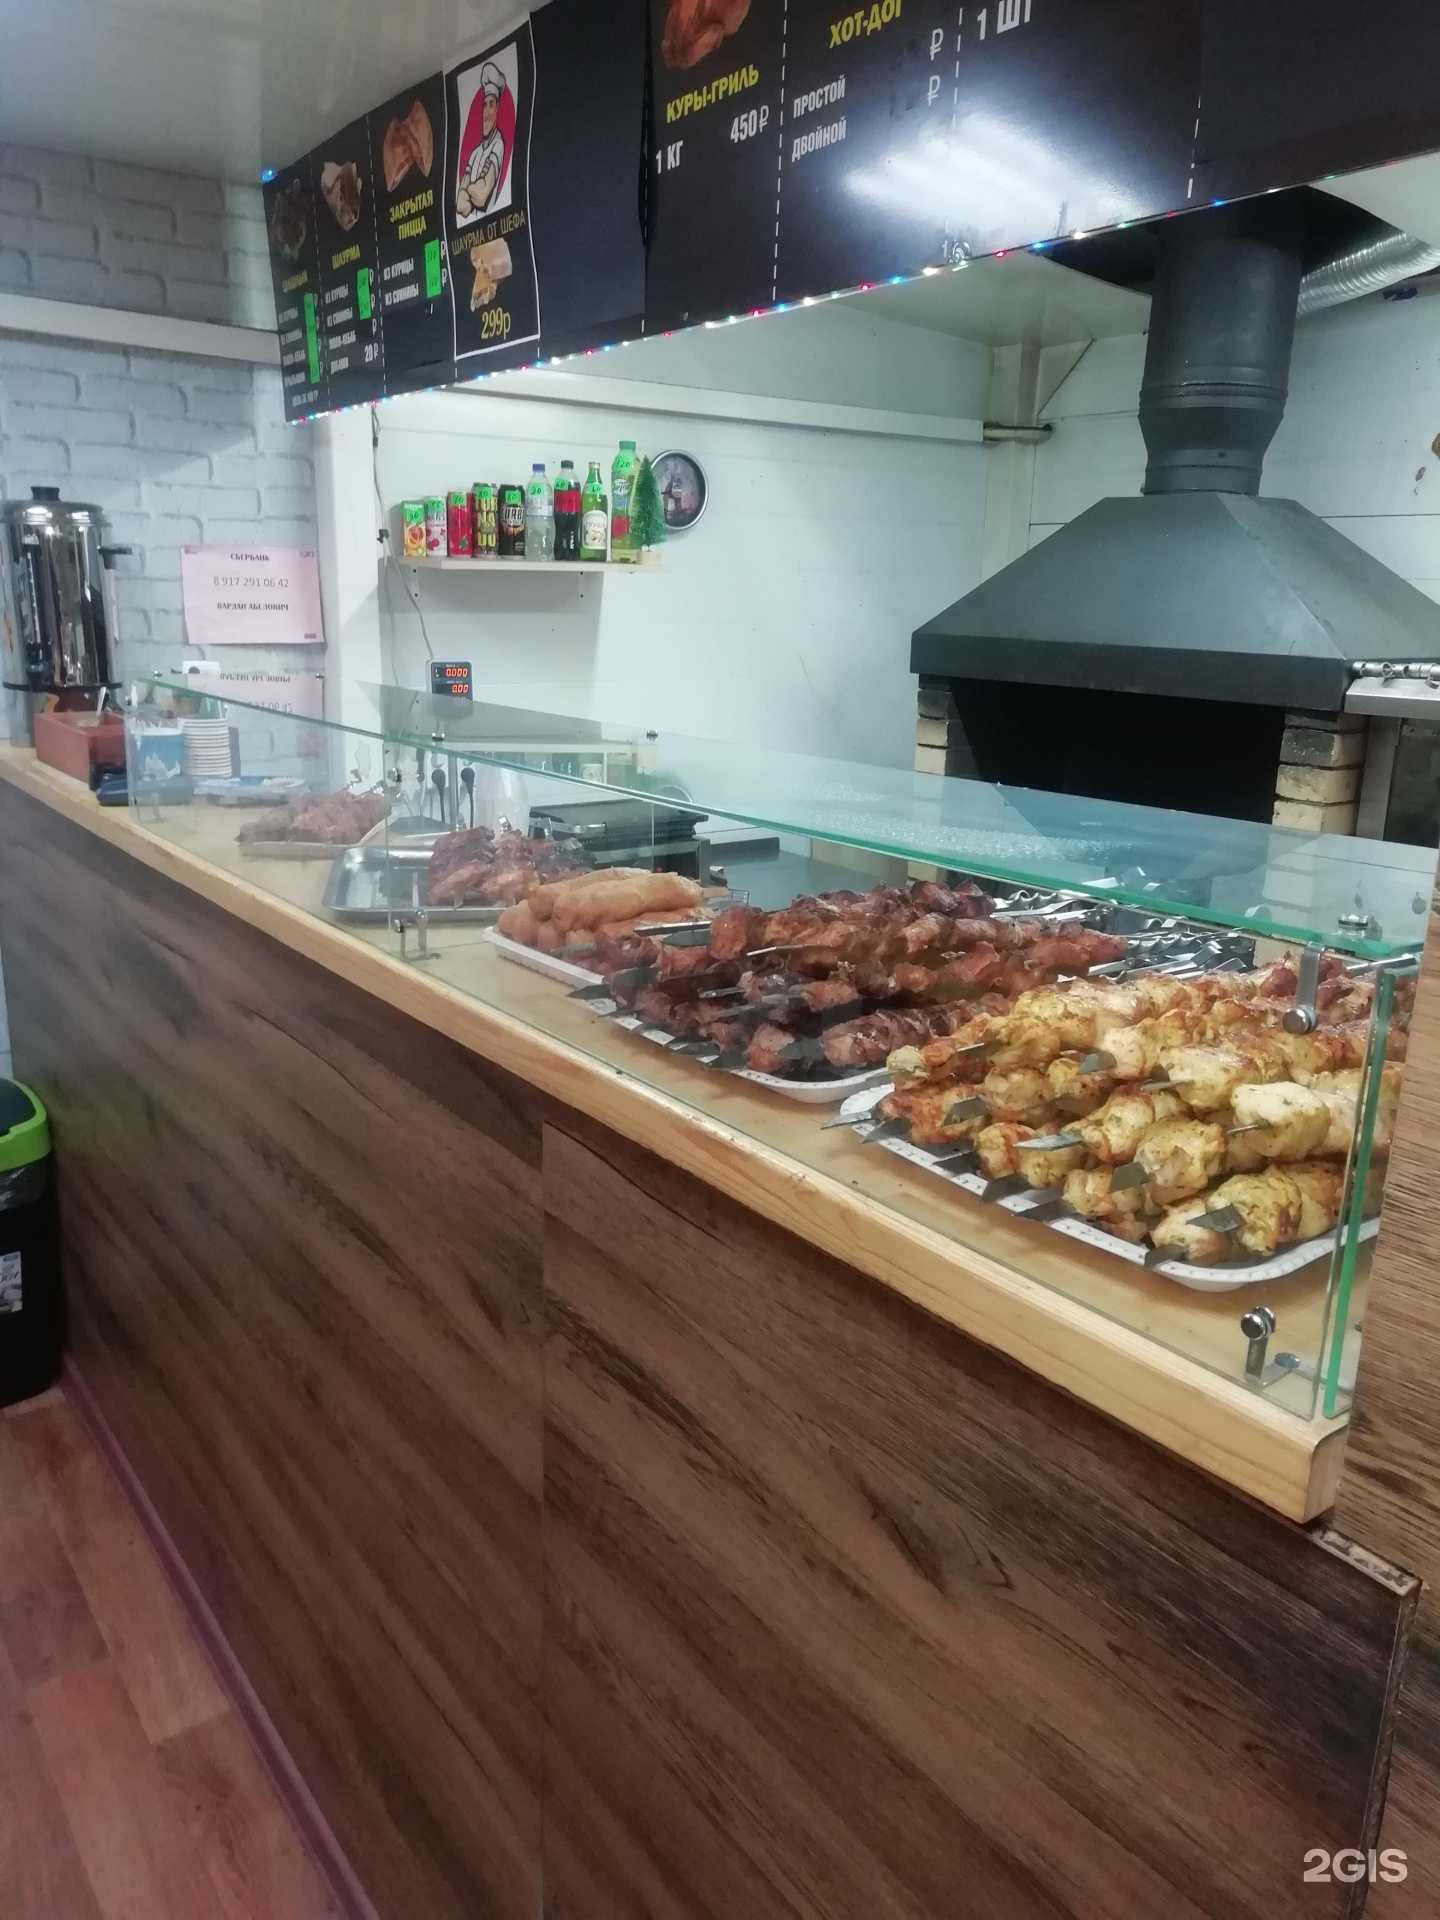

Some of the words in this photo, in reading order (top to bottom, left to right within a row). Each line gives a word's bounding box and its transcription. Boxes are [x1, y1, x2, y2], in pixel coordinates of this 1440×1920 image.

[977, 8, 987, 40] 1
[666, 64, 759, 124] КУРЫ-ГРИЛЬ
[793, 74, 847, 119] ПРОСТОЙ
[791, 116, 847, 163] ДВОЙНОЙ
[656, 150, 662, 174] 1
[667, 140, 684, 170] КГ
[389, 190, 434, 223] ЗАКРЫТАЯ
[398, 215, 427, 240] ПИЦЦА
[451, 229, 485, 255] ШАУРМА
[487, 222, 498, 240] ОТ
[500, 209, 526, 236] ШЕФА
[331, 244, 361, 270] ШАУРМА
[391, 258, 414, 278] КУРИЦЫ
[481, 307, 511, 340] 299р
[230, 553, 270, 562] СБЕРБАНК
[221, 577, 239, 587] 917
[243, 577, 261, 588] 291
[277, 577, 289, 589] 42
